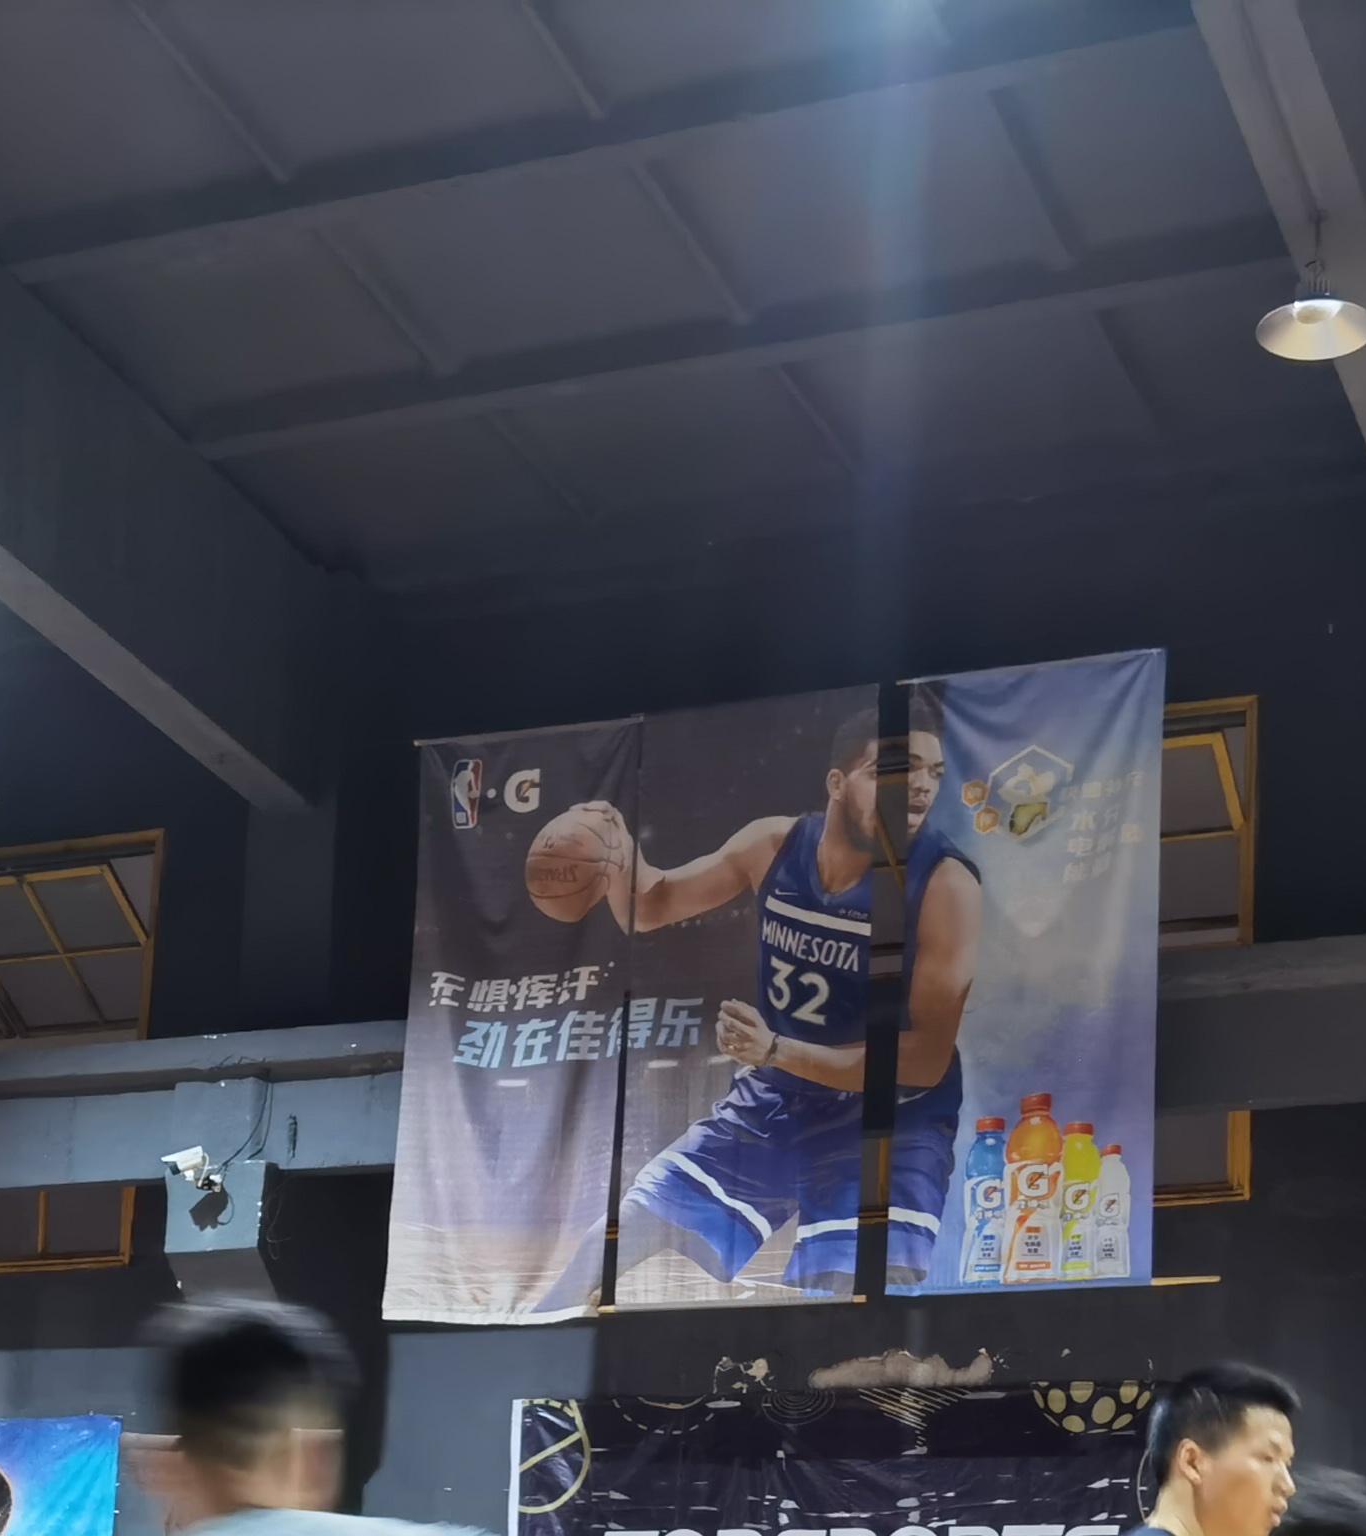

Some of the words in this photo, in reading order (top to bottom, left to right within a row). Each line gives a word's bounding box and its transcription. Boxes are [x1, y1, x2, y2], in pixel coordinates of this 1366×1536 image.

[503, 768, 540, 813] G
[762, 916, 859, 973] MINNESOTA
[429, 965, 601, 1012] 无惧挥汗
[767, 955, 830, 1026] 32
[453, 997, 703, 1068] 劲在佳得乐
